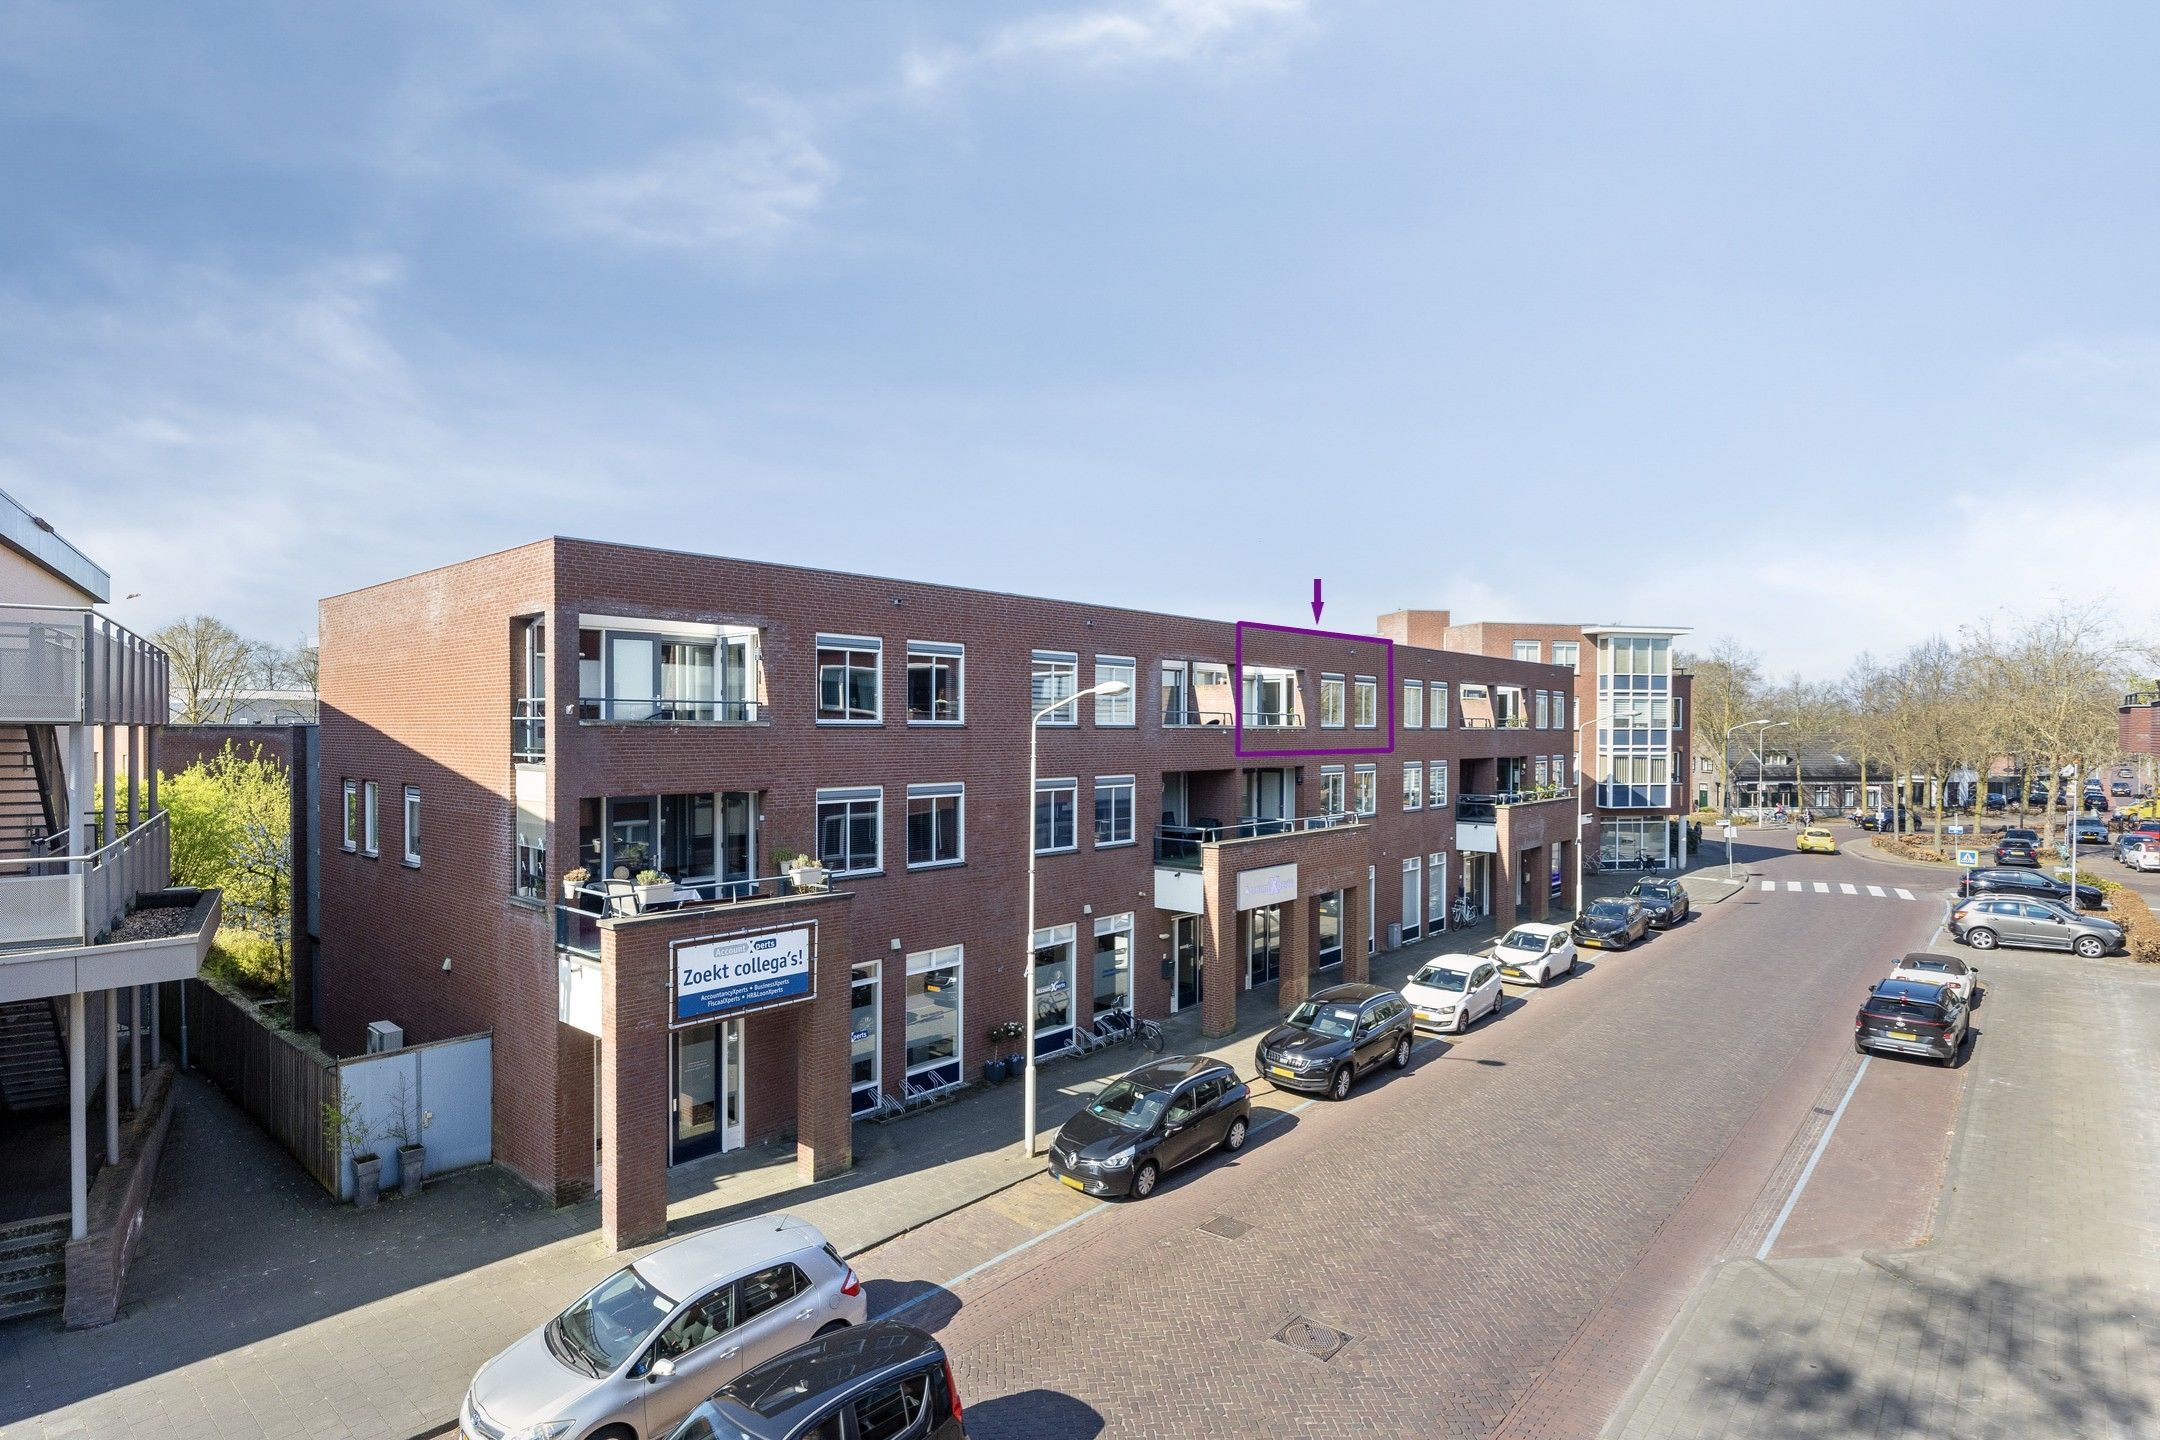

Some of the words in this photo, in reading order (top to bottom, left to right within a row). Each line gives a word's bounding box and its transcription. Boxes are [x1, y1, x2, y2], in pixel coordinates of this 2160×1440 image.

[715, 940, 775, 957] AccountXperts
[683, 964, 729, 987] Zoekt
[734, 949, 803, 977] collega's!
[700, 987, 749, 1001] AccountancyXperts
[754, 979, 790, 991] BusinessXperts
[707, 995, 741, 1007] FiscaalXperts
